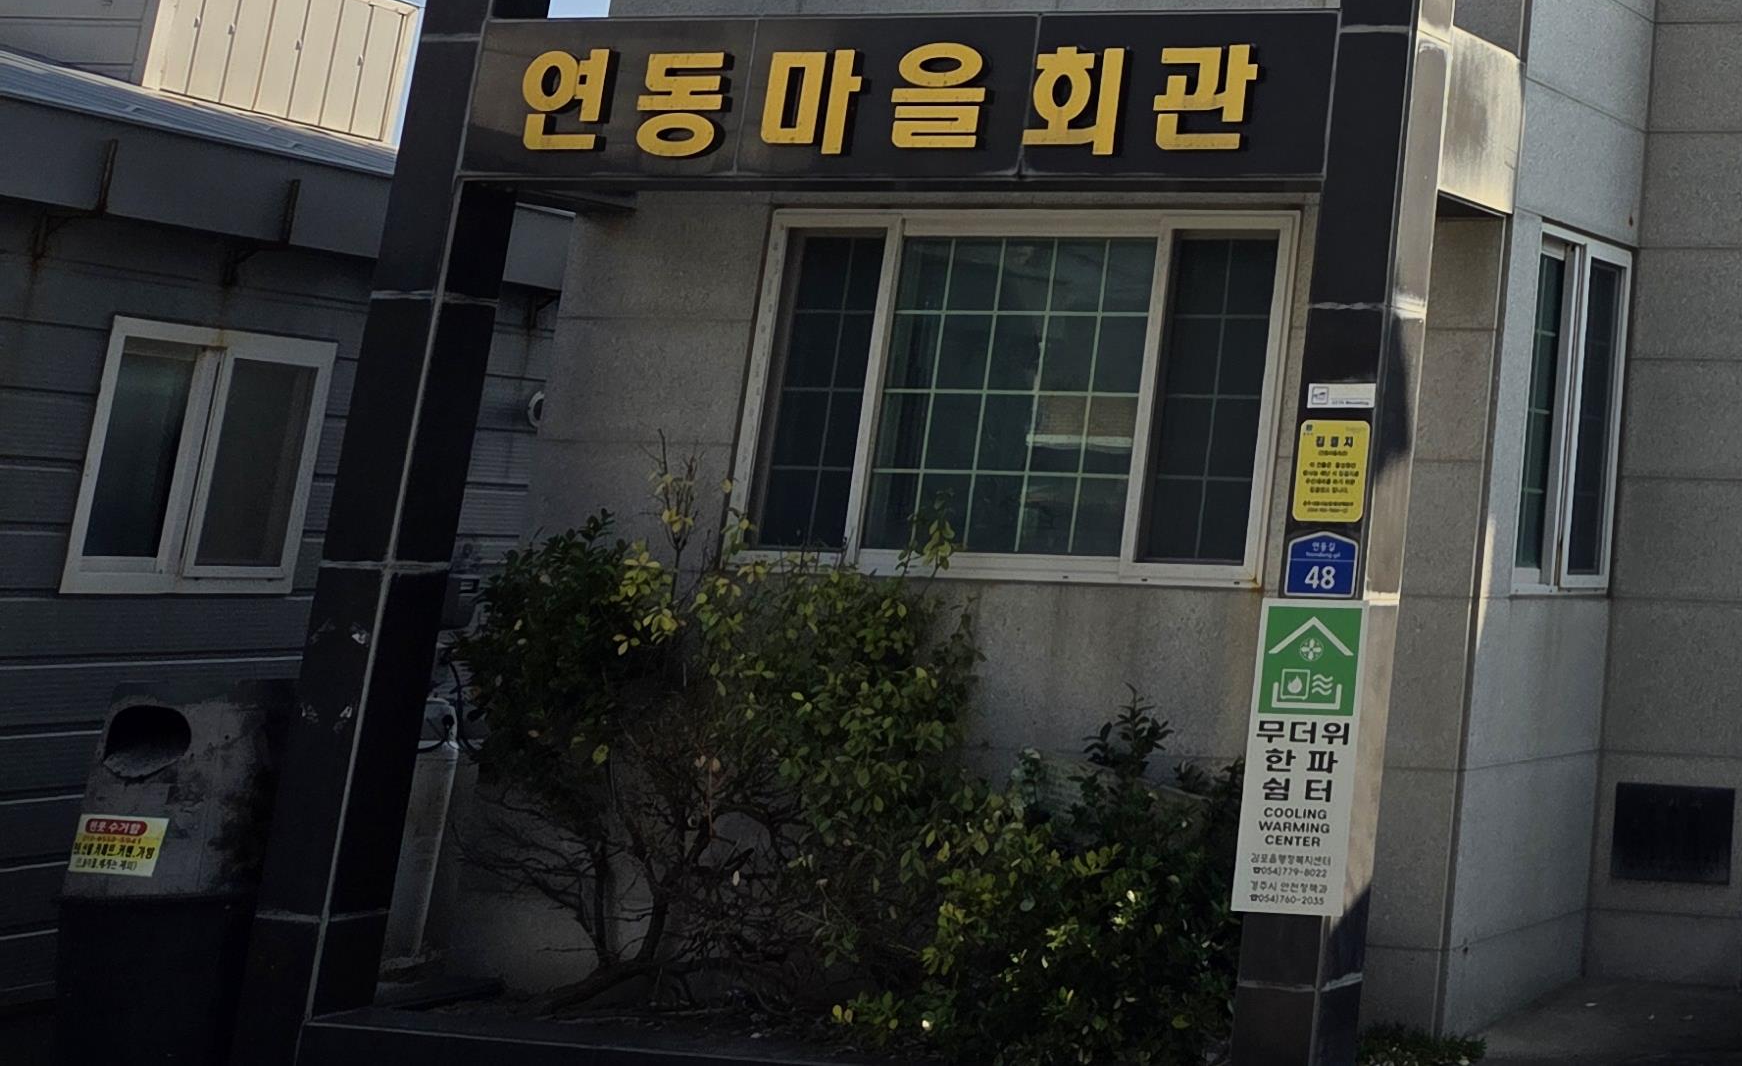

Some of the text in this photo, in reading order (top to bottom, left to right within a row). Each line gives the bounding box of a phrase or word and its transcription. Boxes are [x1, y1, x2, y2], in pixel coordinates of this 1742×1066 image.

[521, 42, 1259, 156] 연동마을회관
[1312, 541, 1336, 552] 연동길
[1304, 565, 1336, 590] 48
[1256, 720, 1350, 745] 무더위
[1263, 807, 1328, 820] COOLING
[108, 822, 141, 835] 수거함
[1258, 821, 1331, 834] WARMING
[1264, 834, 1321, 847] CENTER
[1250, 880, 1328, 894] 경주시 안전정책과
